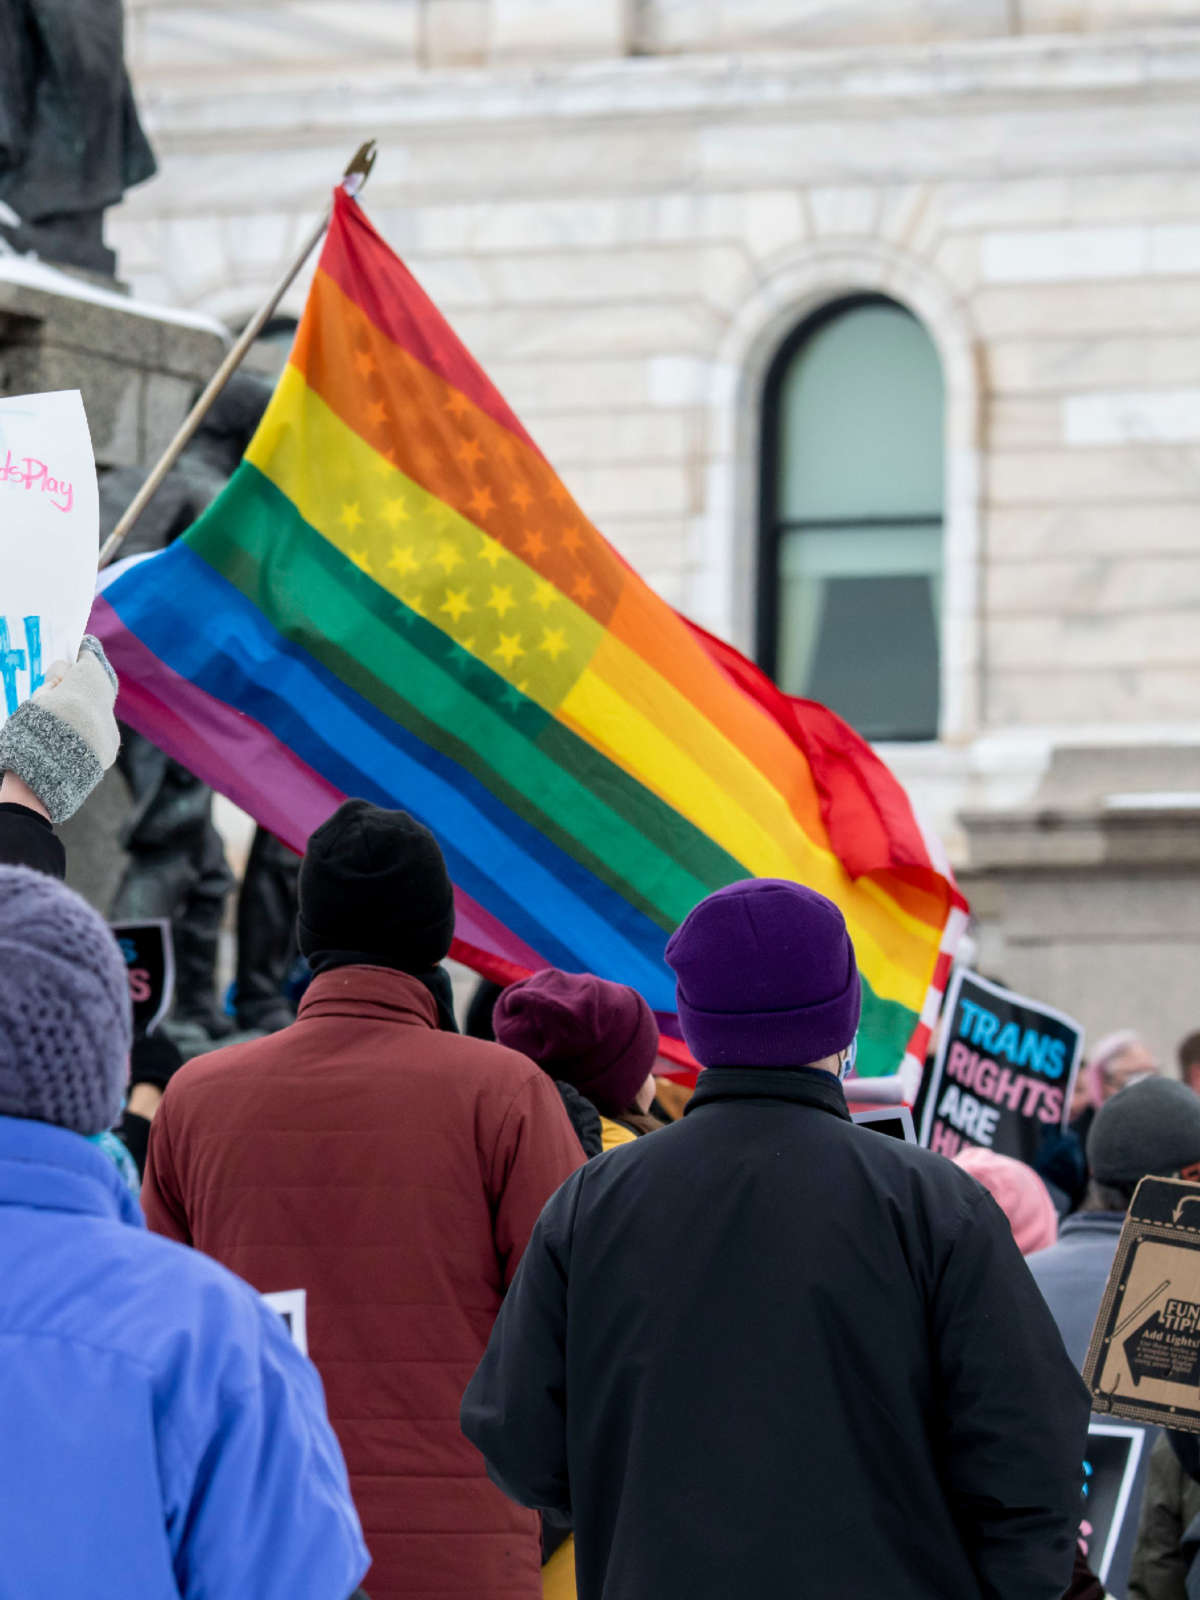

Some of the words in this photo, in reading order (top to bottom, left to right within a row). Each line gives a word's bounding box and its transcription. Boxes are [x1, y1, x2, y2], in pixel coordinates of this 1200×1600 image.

[959, 998, 1067, 1080] TRANS
[937, 1084, 1000, 1147] ARE
[946, 1040, 1064, 1124] RIGHTS
